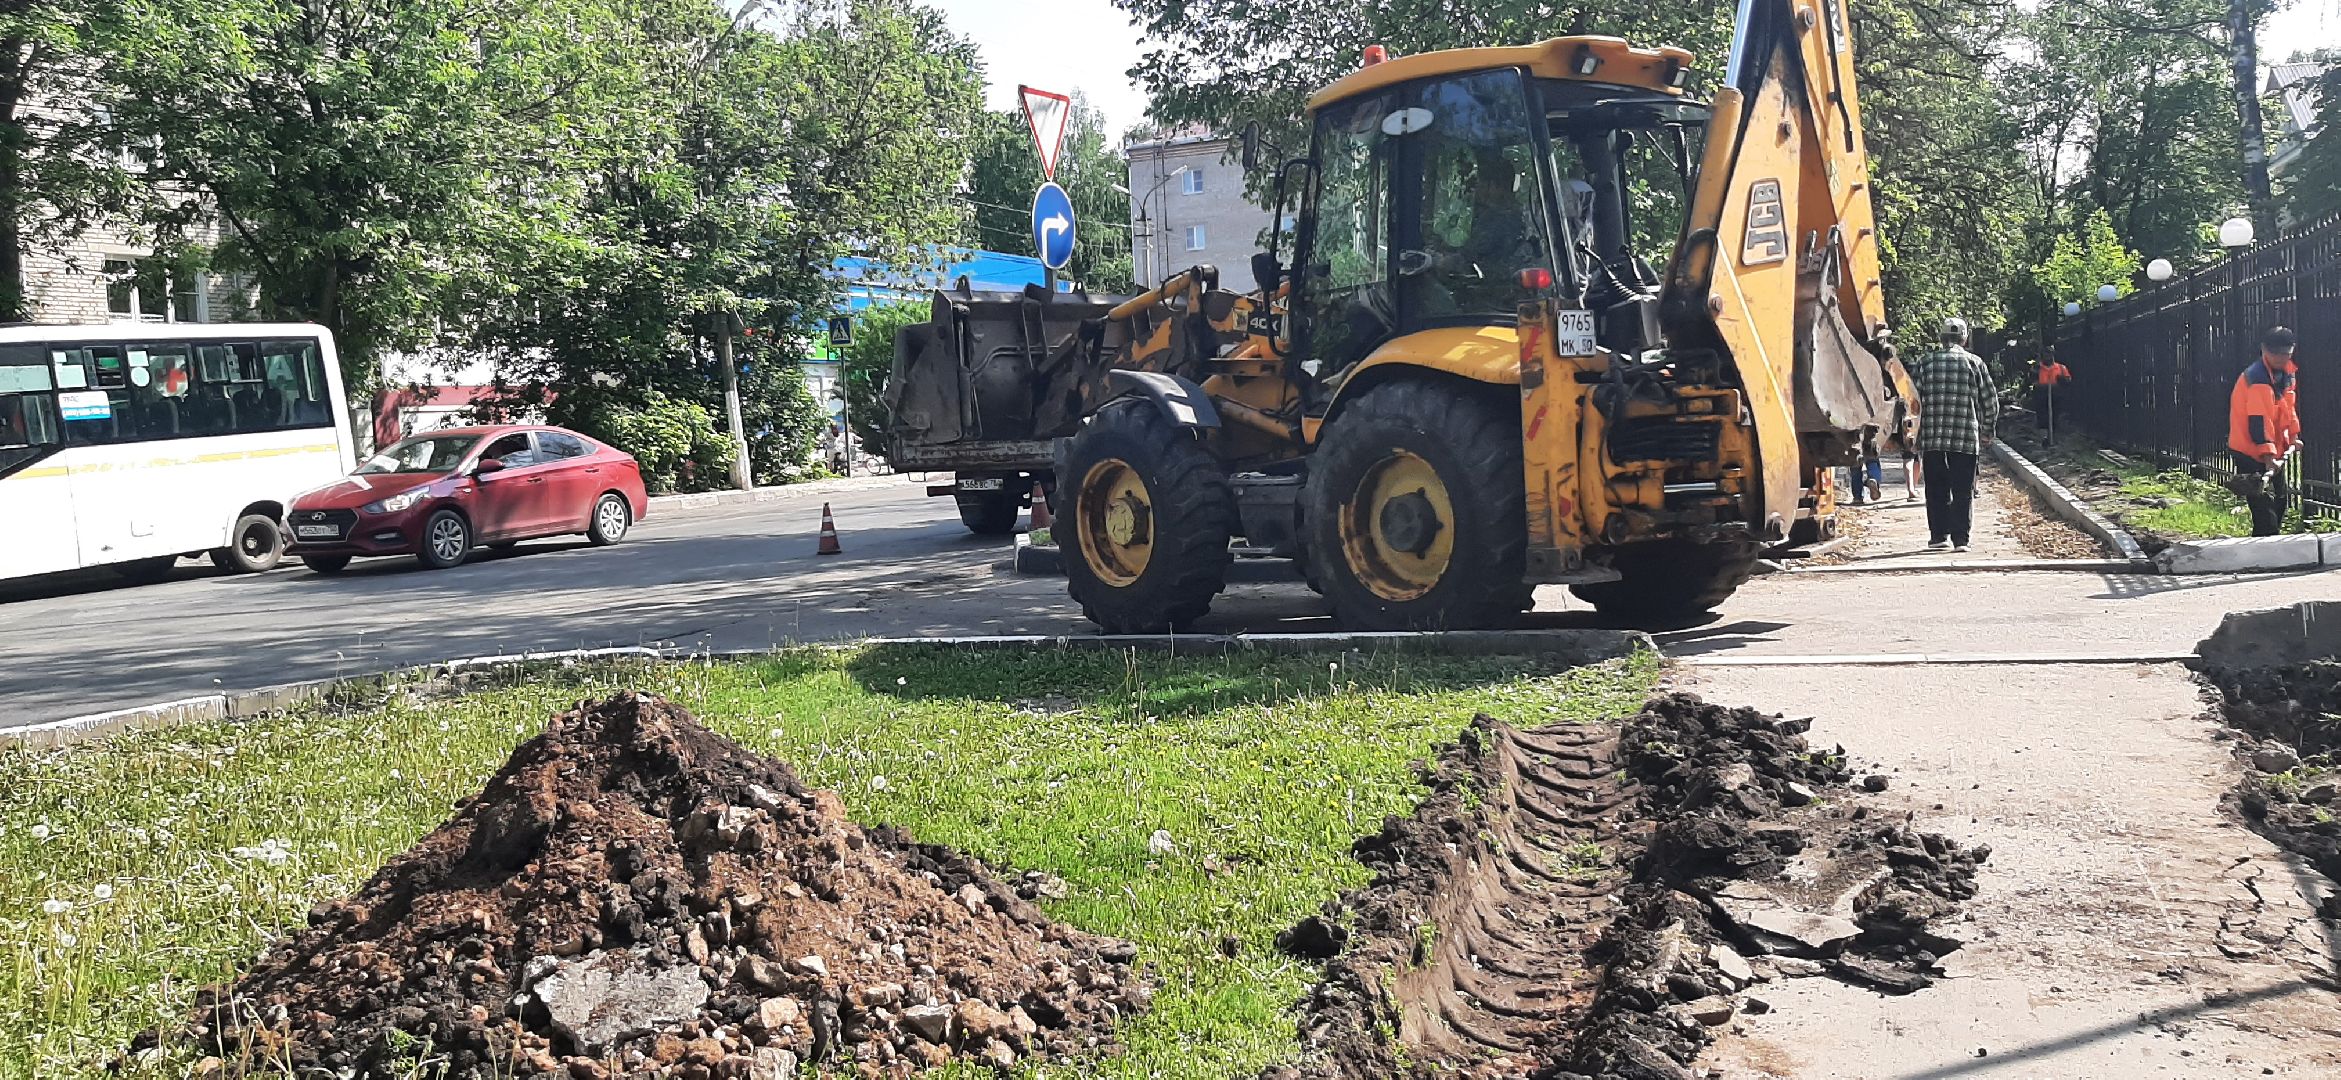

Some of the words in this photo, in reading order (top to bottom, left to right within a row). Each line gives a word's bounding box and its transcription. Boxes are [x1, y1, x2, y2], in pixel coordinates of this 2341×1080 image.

[1747, 184, 1784, 256] JCB
[1561, 314, 1591, 332] 9765
[1560, 339, 1576, 354] МК
[1581, 338, 1593, 352] 50
